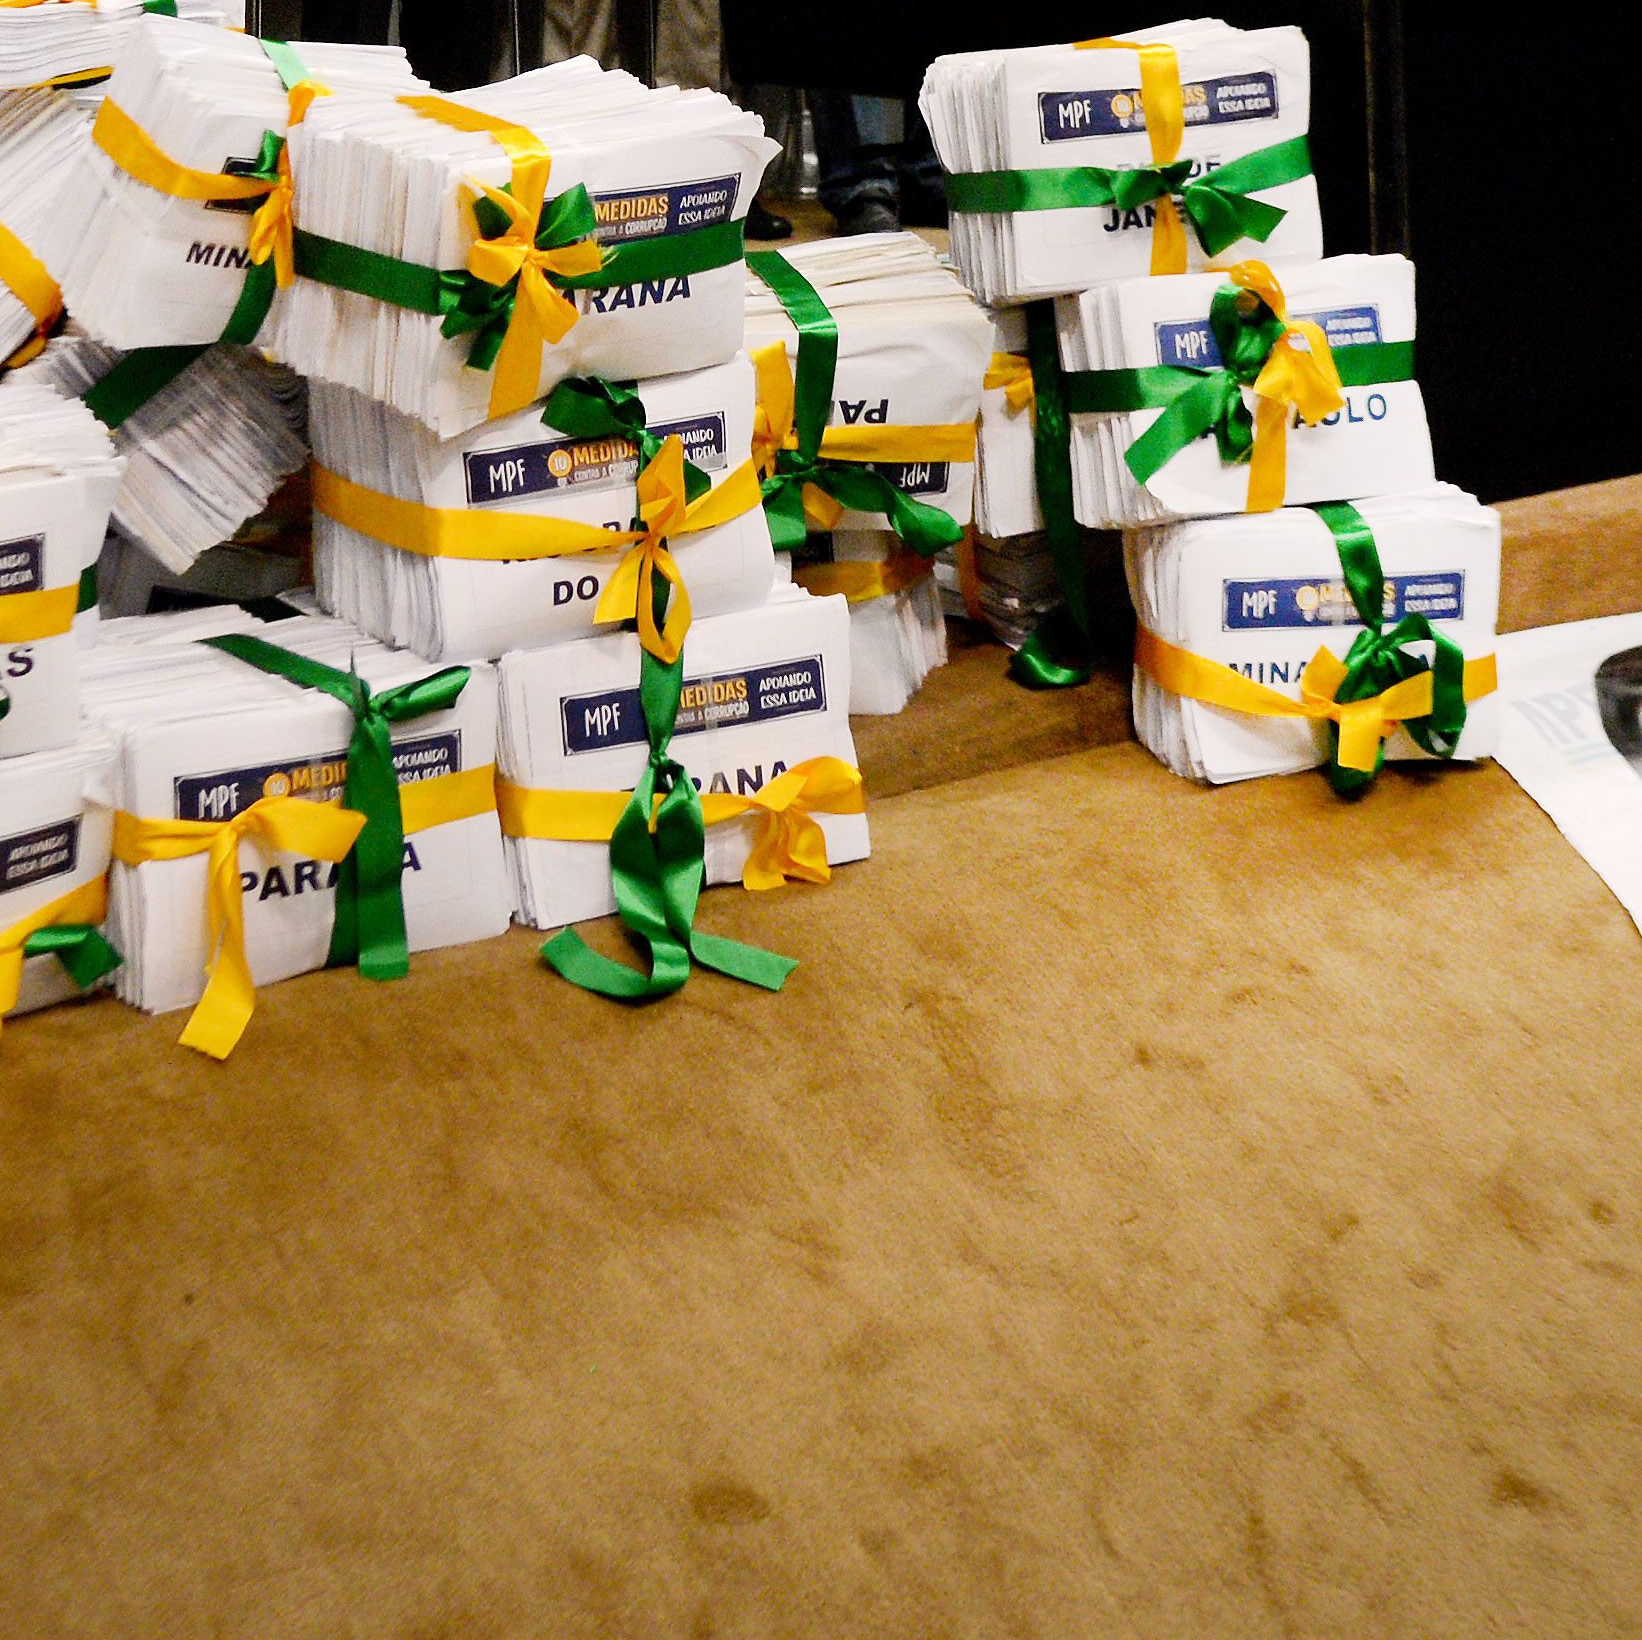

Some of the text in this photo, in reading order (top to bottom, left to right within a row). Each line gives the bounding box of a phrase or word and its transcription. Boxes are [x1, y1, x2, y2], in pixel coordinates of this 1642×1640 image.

[1058, 99, 1092, 130] MPF
[593, 194, 670, 224] MEDIDAS
[679, 189, 729, 209] APOIANDO
[677, 209, 703, 226] ESSA
[1174, 329, 1209, 361] MPF
[488, 457, 526, 494] MPF
[573, 440, 640, 467] MEDIDA
[552, 574, 600, 606] DO
[1241, 589, 1278, 620] MPF
[758, 671, 812, 693] APOIANDO
[760, 686, 817, 710] ESSA IDEIA
[583, 701, 623, 738] MPF
[197, 782, 241, 819] MPF
